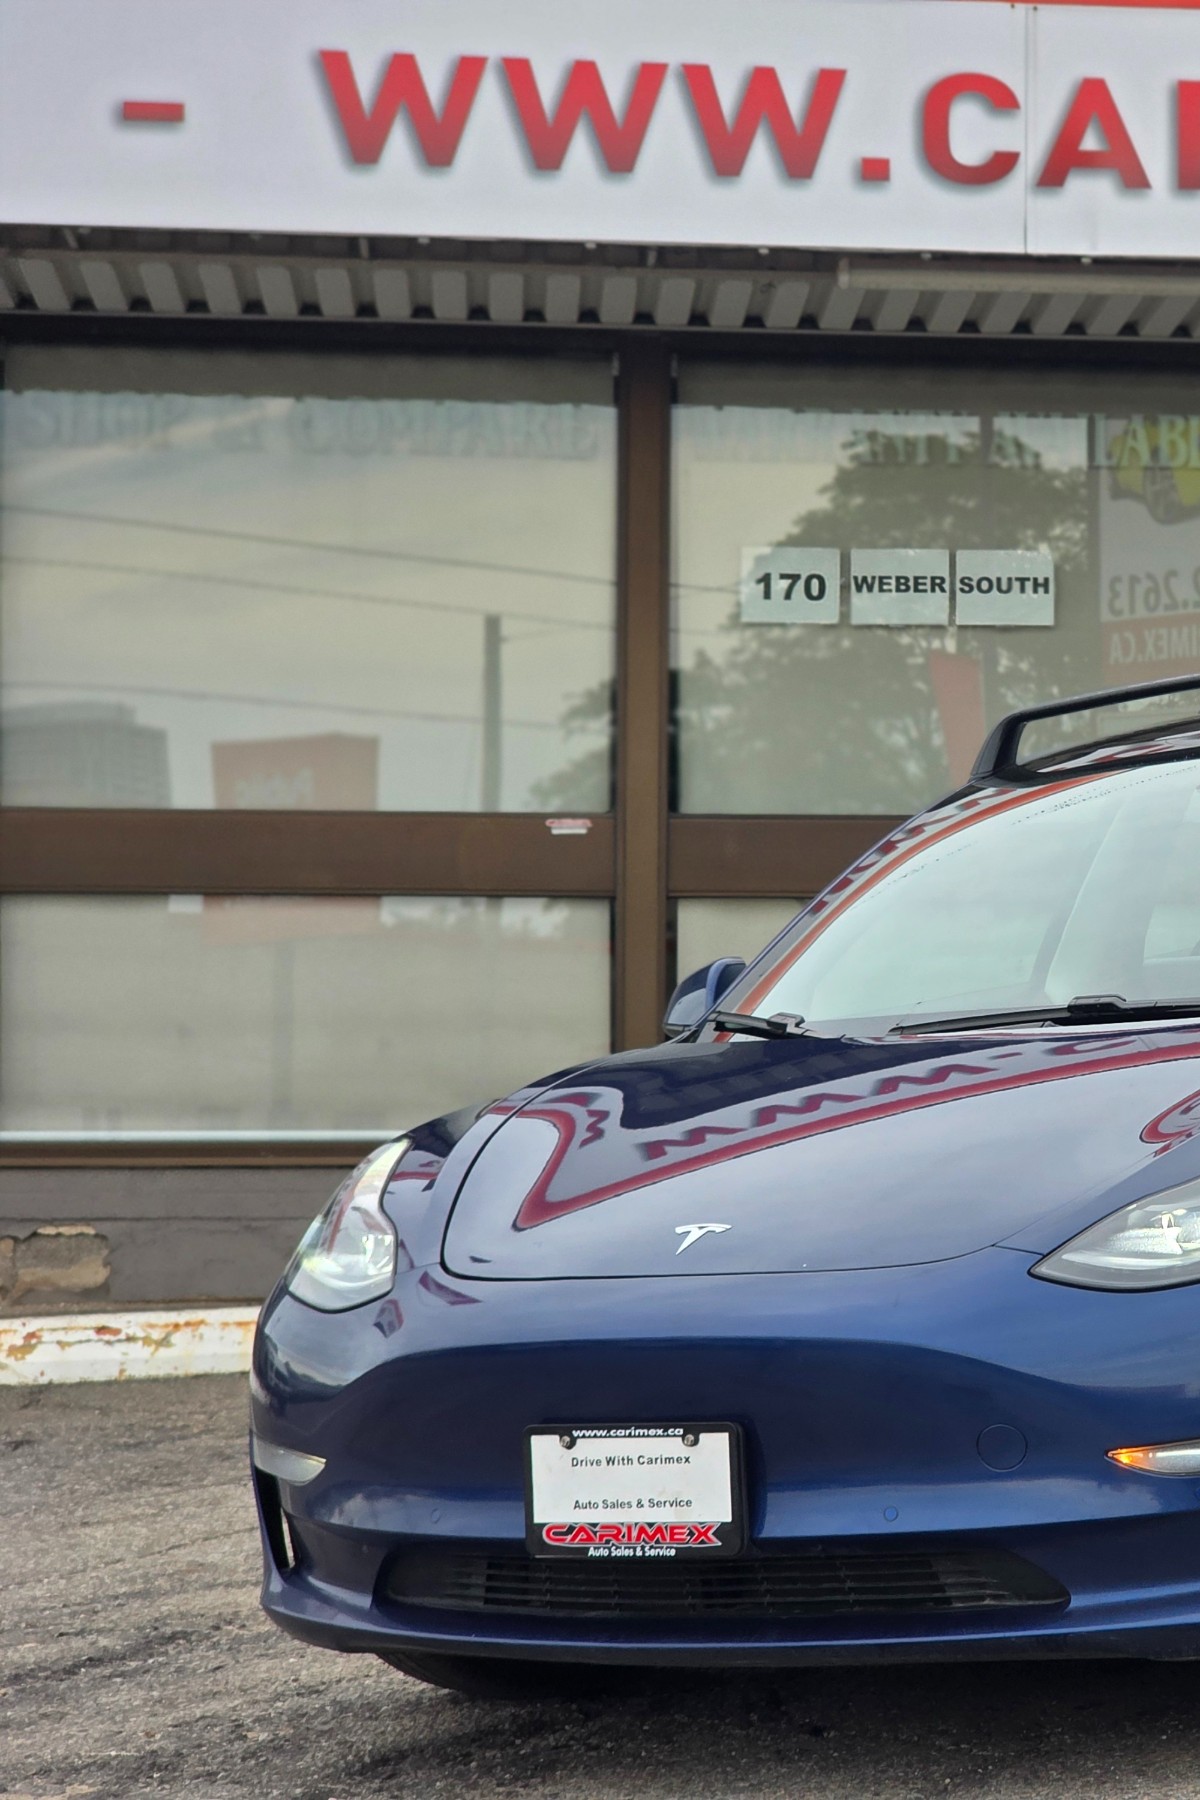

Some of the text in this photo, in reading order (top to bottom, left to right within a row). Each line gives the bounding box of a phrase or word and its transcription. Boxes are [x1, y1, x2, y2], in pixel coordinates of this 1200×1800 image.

[754, 572, 1051, 602] 170 WEBER SOUTH
[571, 1426, 684, 1438] www.carimex.ca
[571, 1454, 691, 1468] Drive With Carimex
[573, 1498, 693, 1511] Auto Sales & Service
[542, 1522, 723, 1546] CARIMEX
[588, 1546, 676, 1557] Auto Sales & Service
